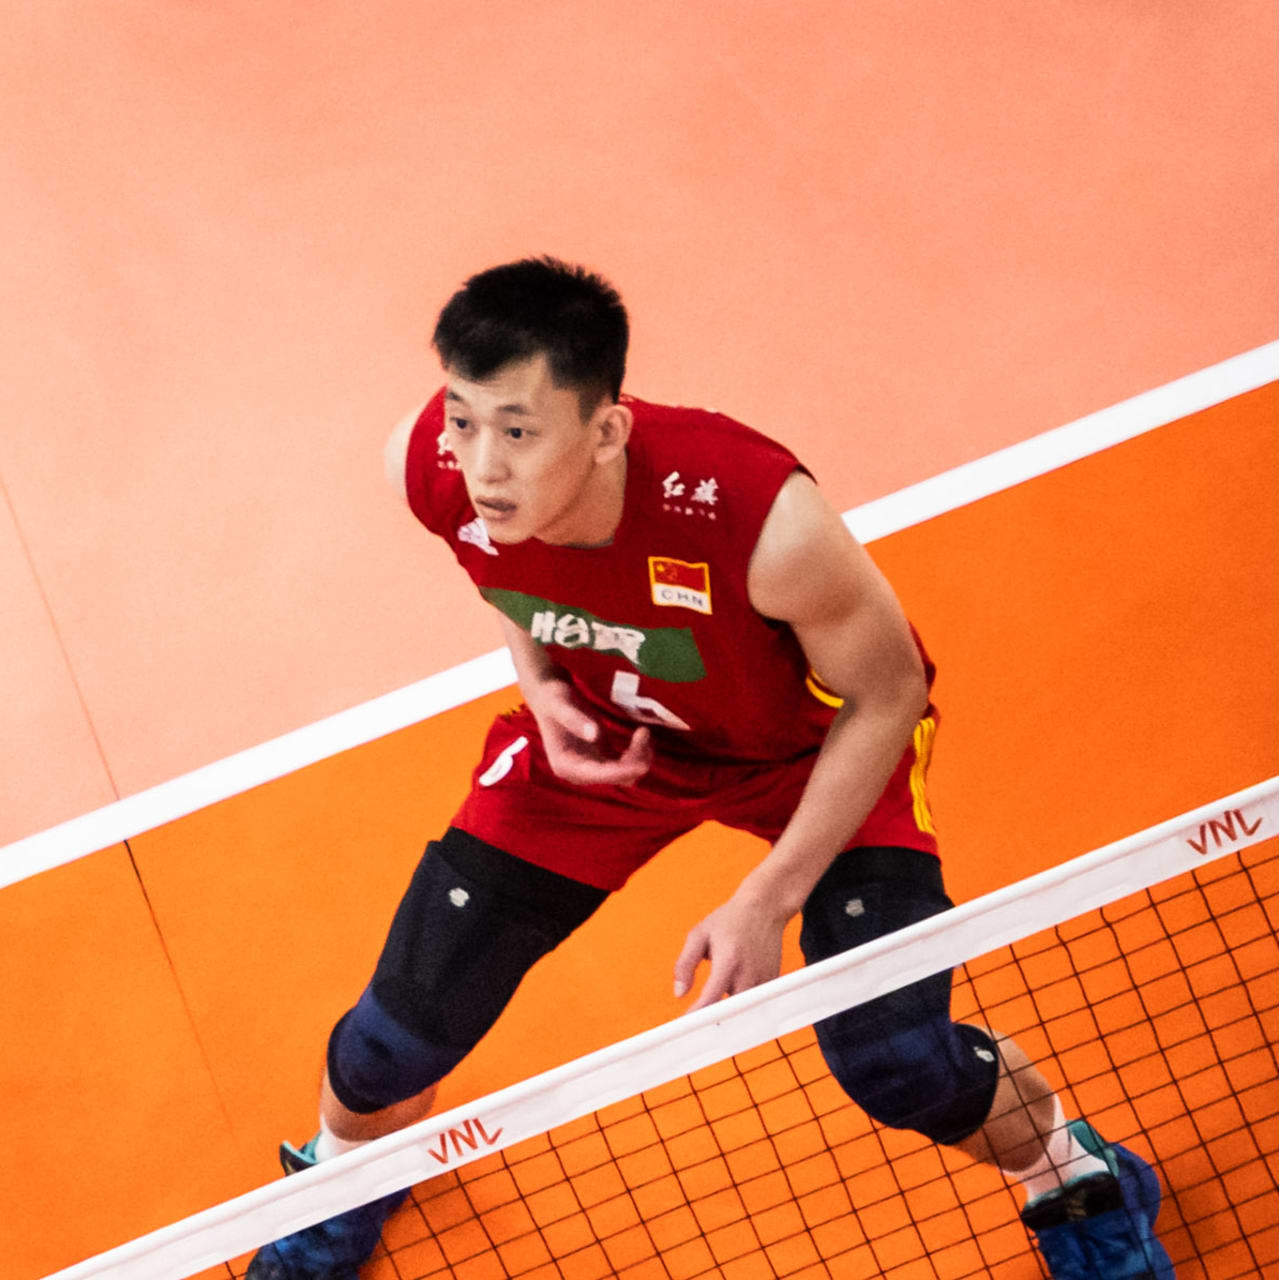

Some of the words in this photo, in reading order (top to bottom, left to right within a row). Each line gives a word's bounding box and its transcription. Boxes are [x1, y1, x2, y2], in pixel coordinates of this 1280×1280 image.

[661, 588, 703, 607] CHN
[478, 736, 529, 787] 6
[1186, 808, 1263, 855] VNL
[429, 1118, 504, 1164] VNL
